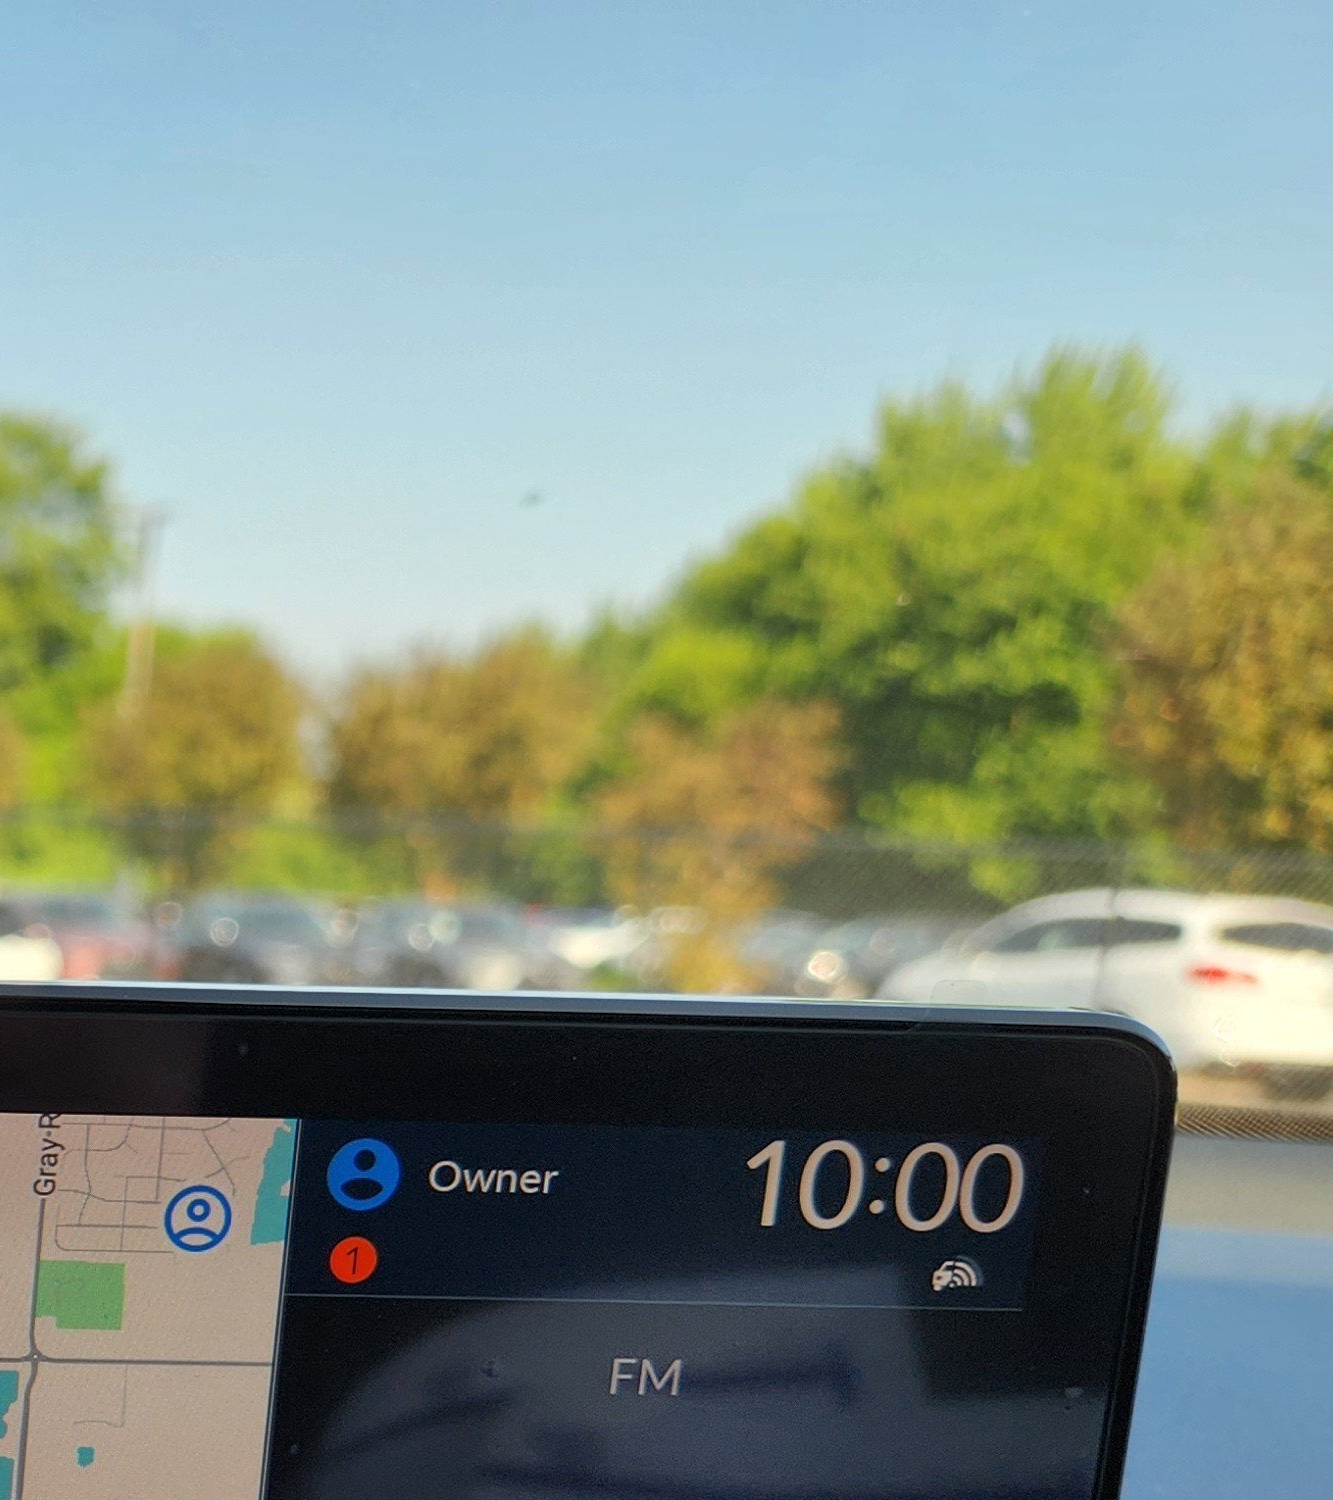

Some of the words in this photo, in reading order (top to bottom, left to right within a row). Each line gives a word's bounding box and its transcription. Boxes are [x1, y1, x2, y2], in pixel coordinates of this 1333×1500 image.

[38, 1113, 61, 1129] R
[33, 1138, 66, 1196] Gray
[428, 1159, 559, 1197] Owner
[746, 1138, 1026, 1234] 10:00
[344, 1245, 362, 1275] 1
[609, 1357, 683, 1398] FM
